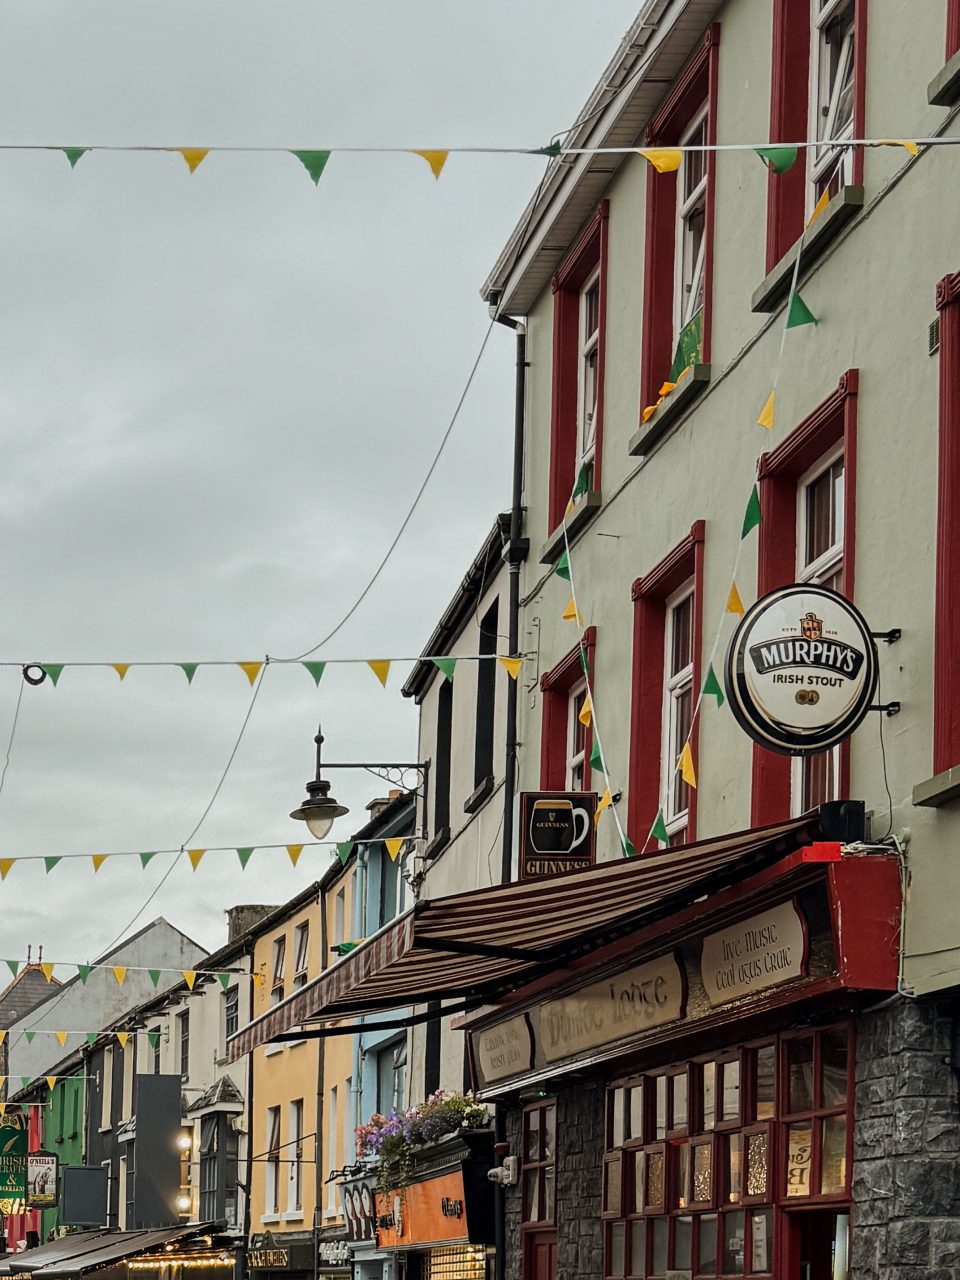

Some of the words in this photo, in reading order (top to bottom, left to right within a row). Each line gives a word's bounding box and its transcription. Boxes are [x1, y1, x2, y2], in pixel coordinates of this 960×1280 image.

[760, 641, 856, 672] MURPHY'S
[772, 674, 804, 685] IRISH
[807, 677, 845, 688] STOUT
[0, 1156, 26, 1165] IRISH
[6, 1173, 16, 1185] &
